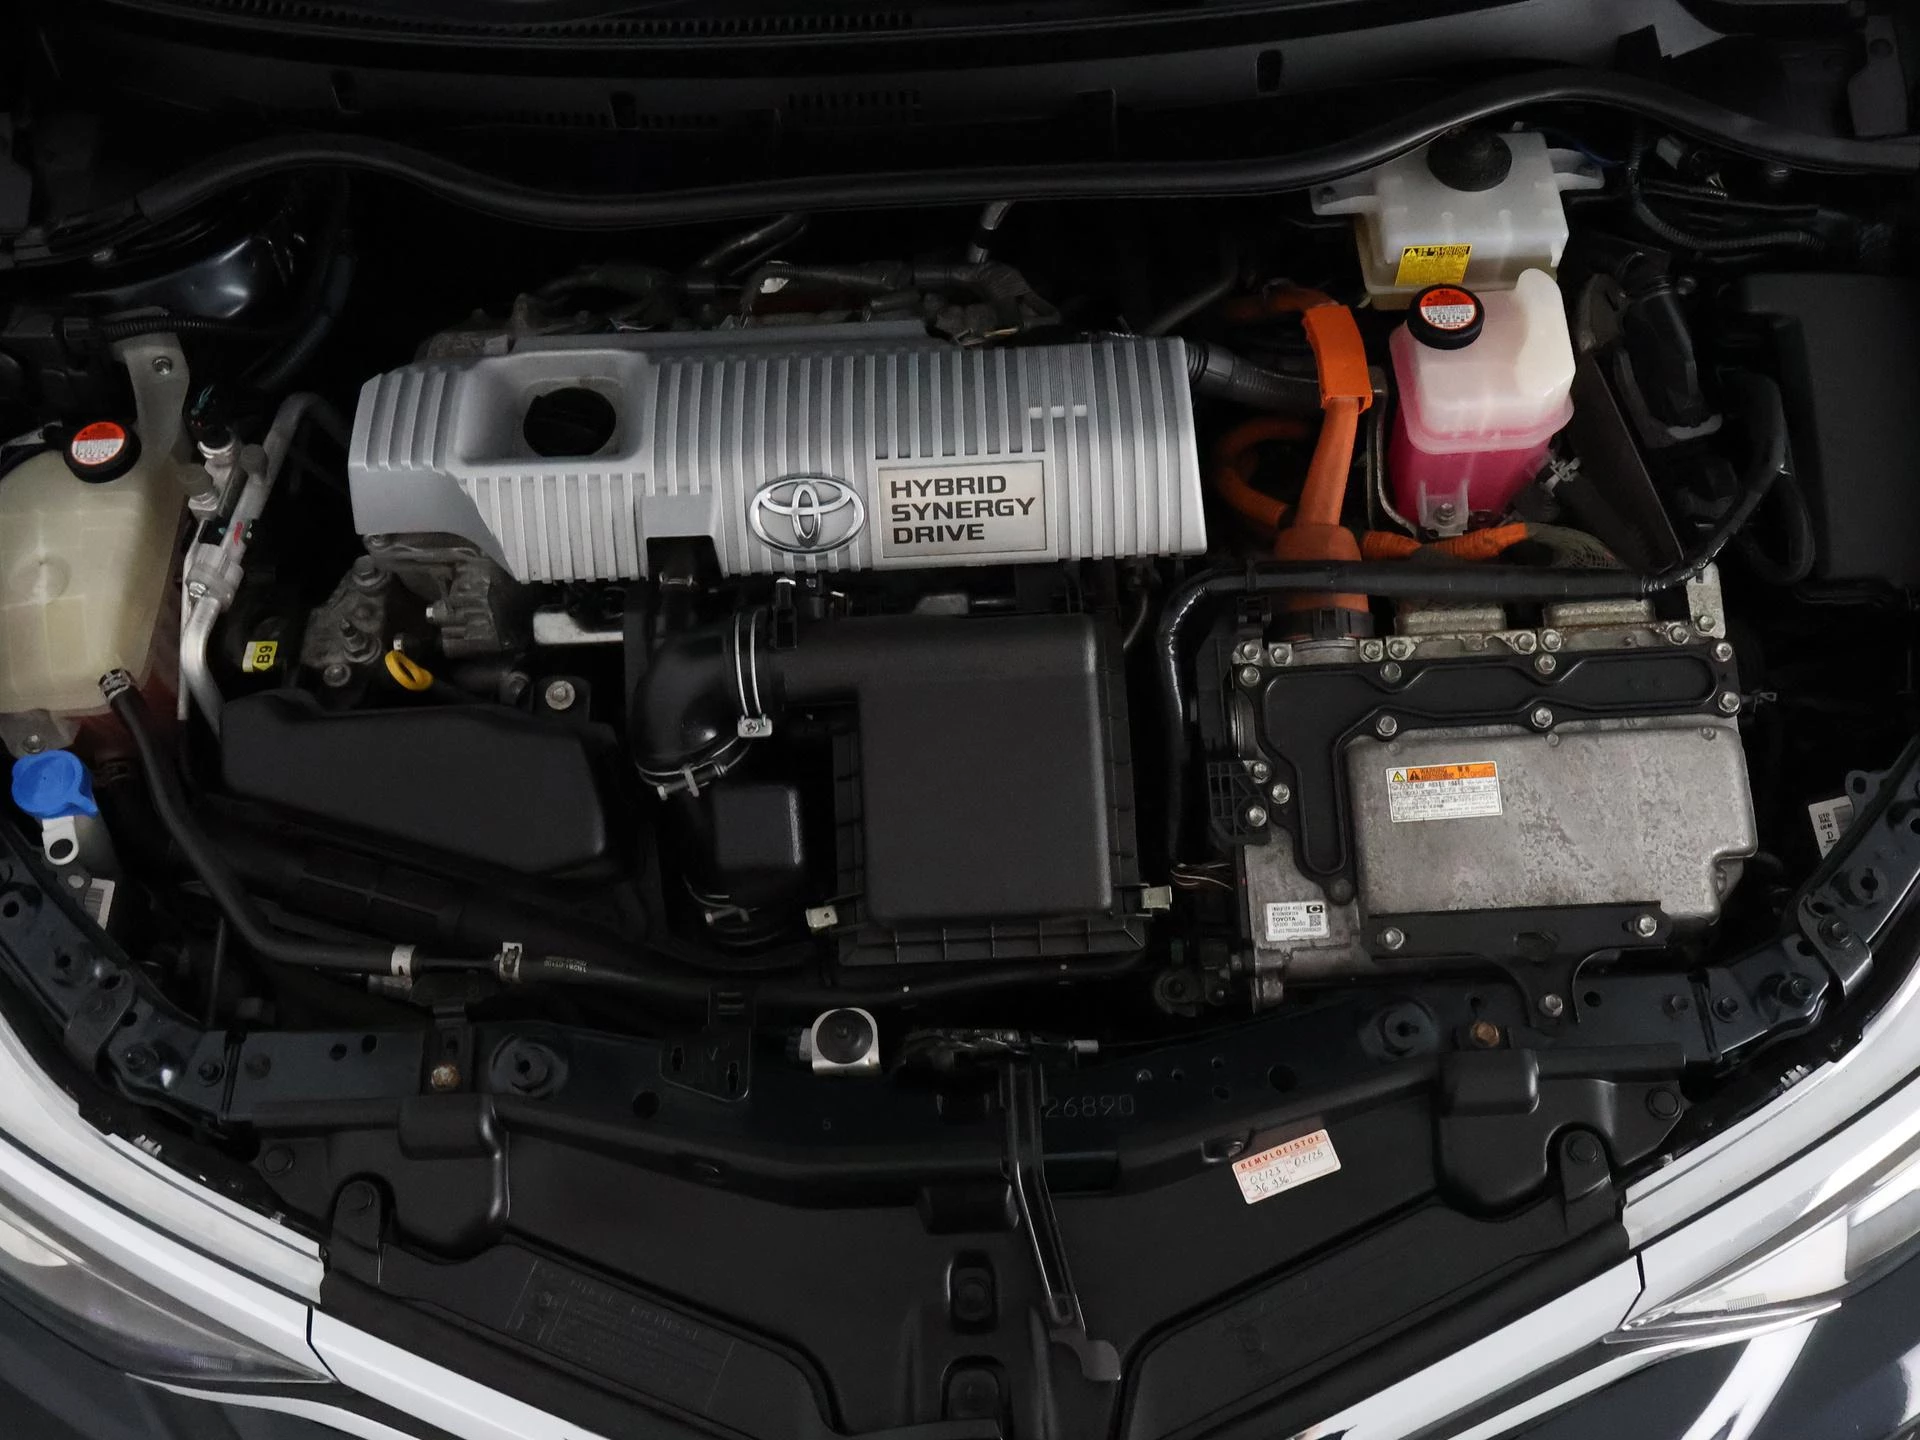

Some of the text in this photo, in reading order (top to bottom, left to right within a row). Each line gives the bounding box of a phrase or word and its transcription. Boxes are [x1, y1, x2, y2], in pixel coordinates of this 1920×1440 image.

[891, 475, 1007, 498] HYBRID
[891, 497, 1035, 522] SYNERGY
[893, 523, 985, 544] DRIVE
[256, 646, 273, 663] B9
[1240, 1135, 1321, 1170] REMVLOEISTOF
